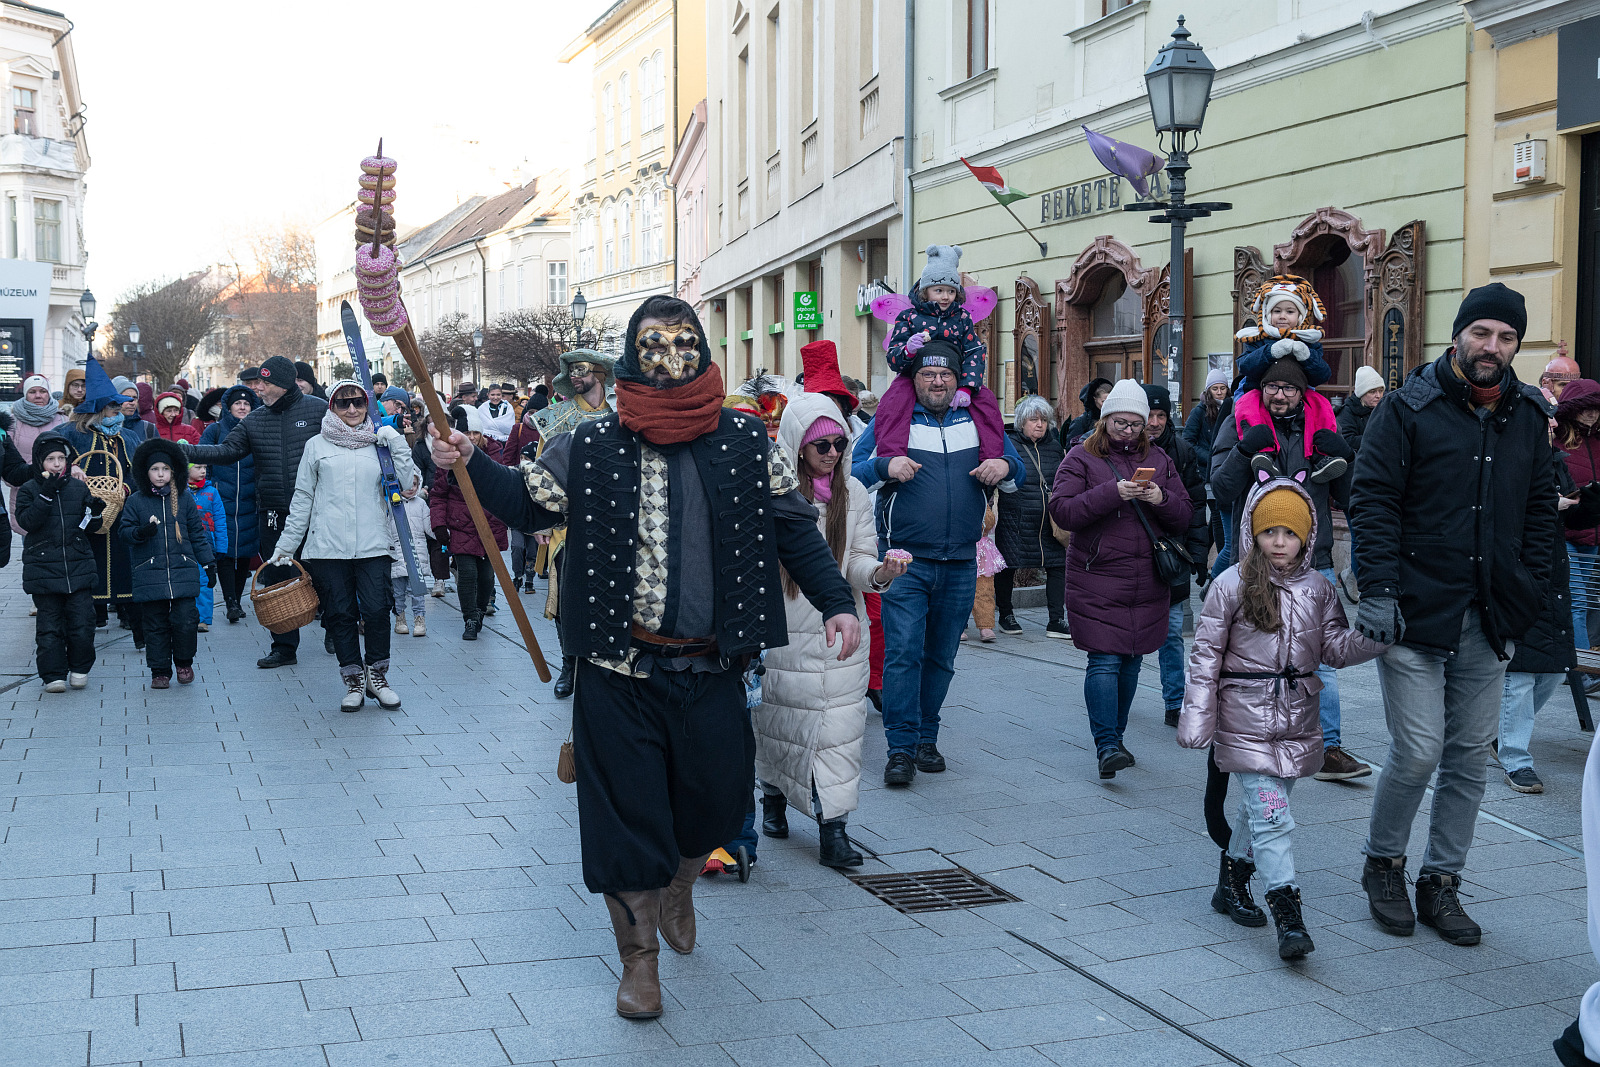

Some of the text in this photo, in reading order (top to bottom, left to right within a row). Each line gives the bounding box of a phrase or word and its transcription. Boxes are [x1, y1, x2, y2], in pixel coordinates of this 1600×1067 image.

[1040, 176, 1121, 223] FEKETE
[797, 313, 815, 321] 0-24
[922, 355, 949, 367] MARVEL
[1258, 790, 1279, 803] STAY
